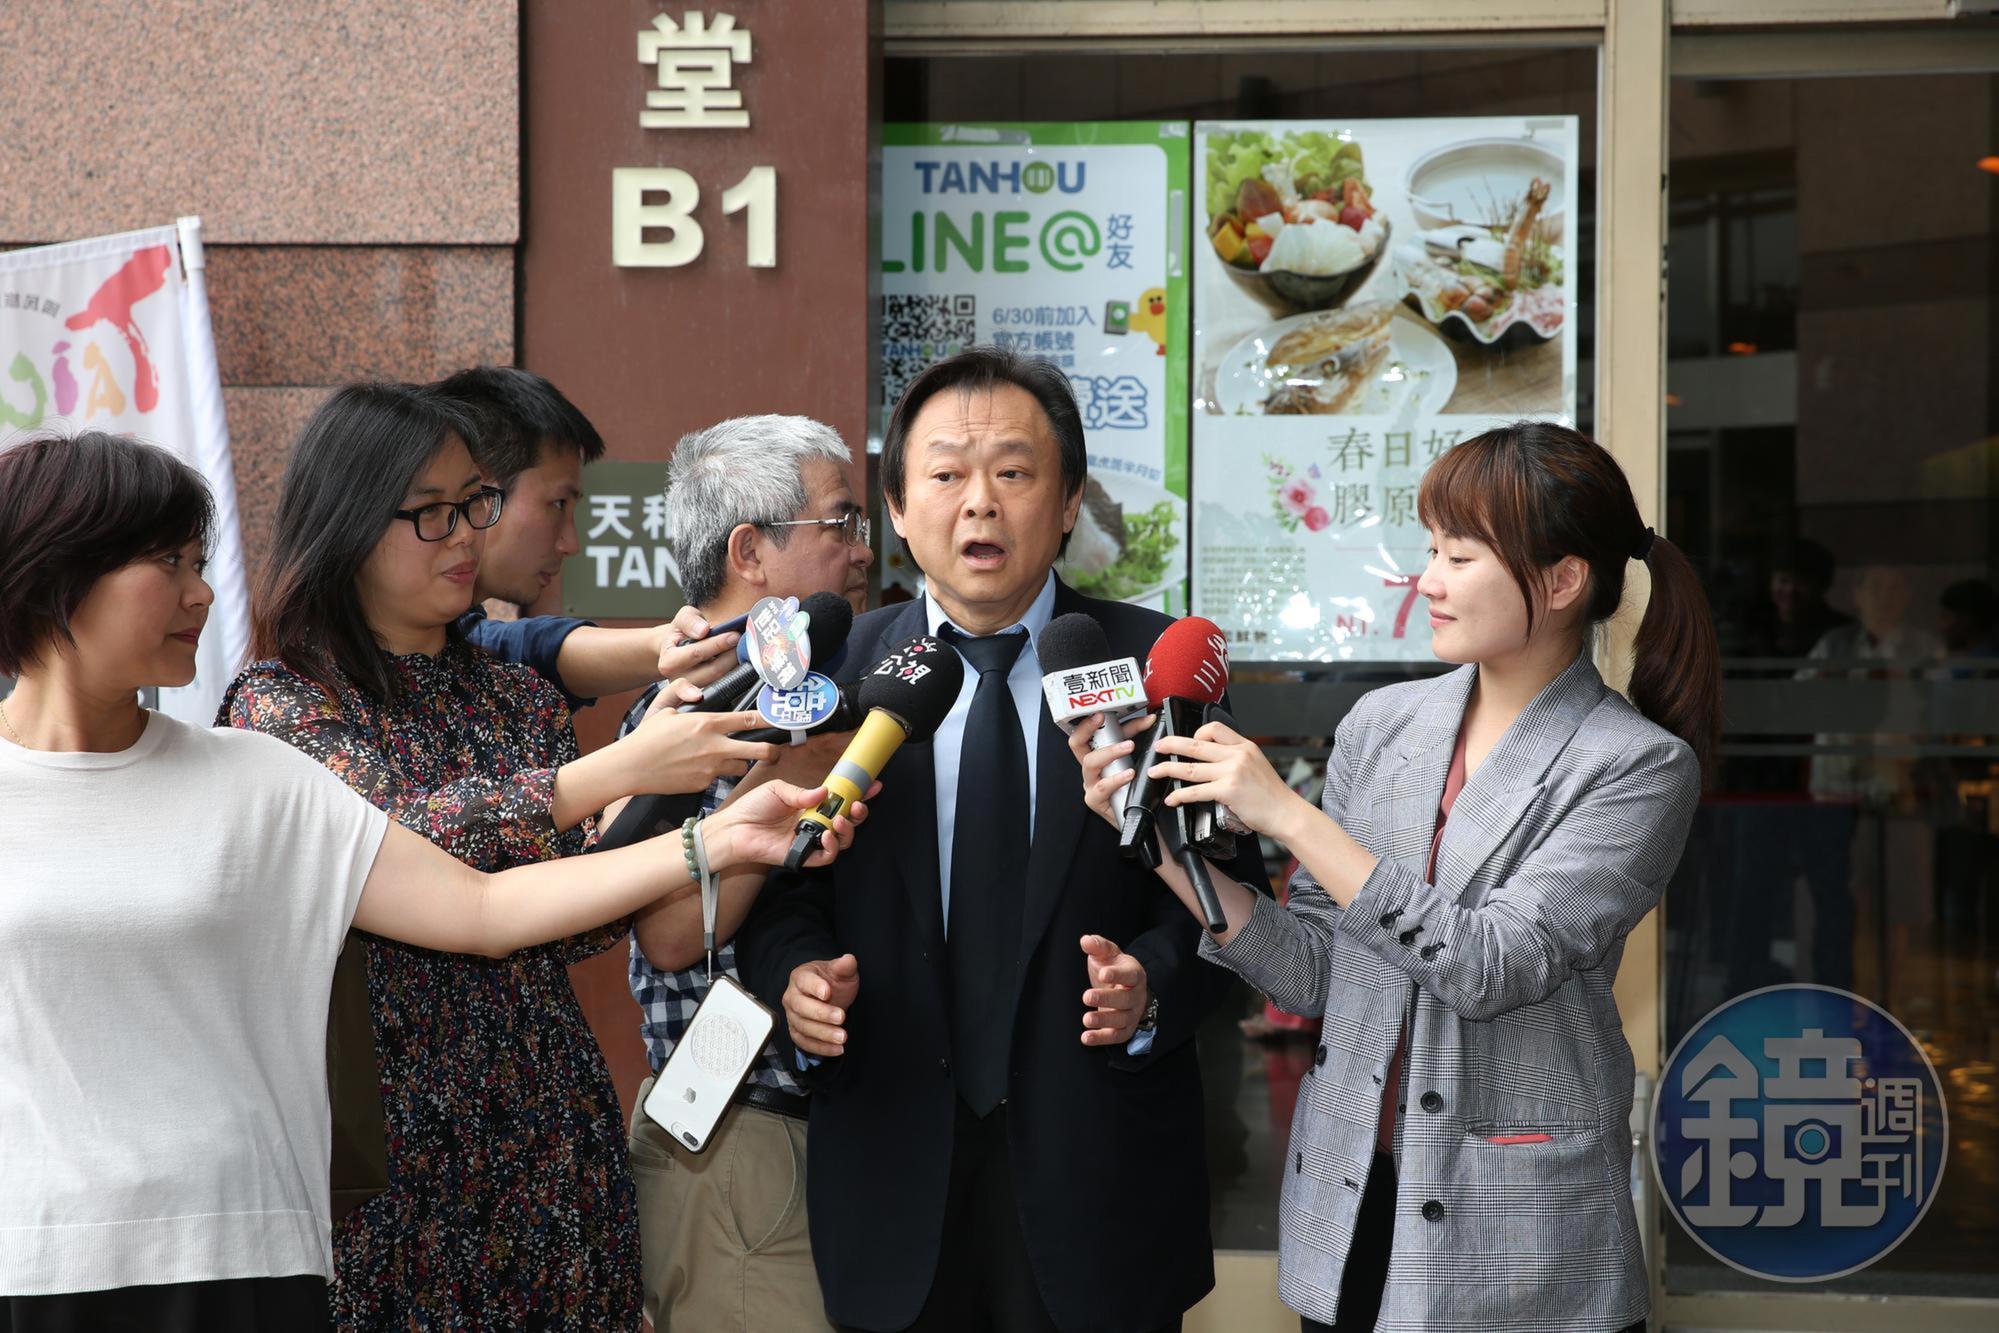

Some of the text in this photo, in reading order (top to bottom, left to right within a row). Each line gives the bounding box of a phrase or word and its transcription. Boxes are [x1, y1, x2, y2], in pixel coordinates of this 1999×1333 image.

[637, 10, 752, 128] 堂
[914, 160, 1086, 194] TANHOU
[612, 166, 776, 268] B1
[1106, 213, 1134, 270] 好友
[873, 654, 932, 686] 公視
[1063, 664, 1134, 695] 壹新聞
